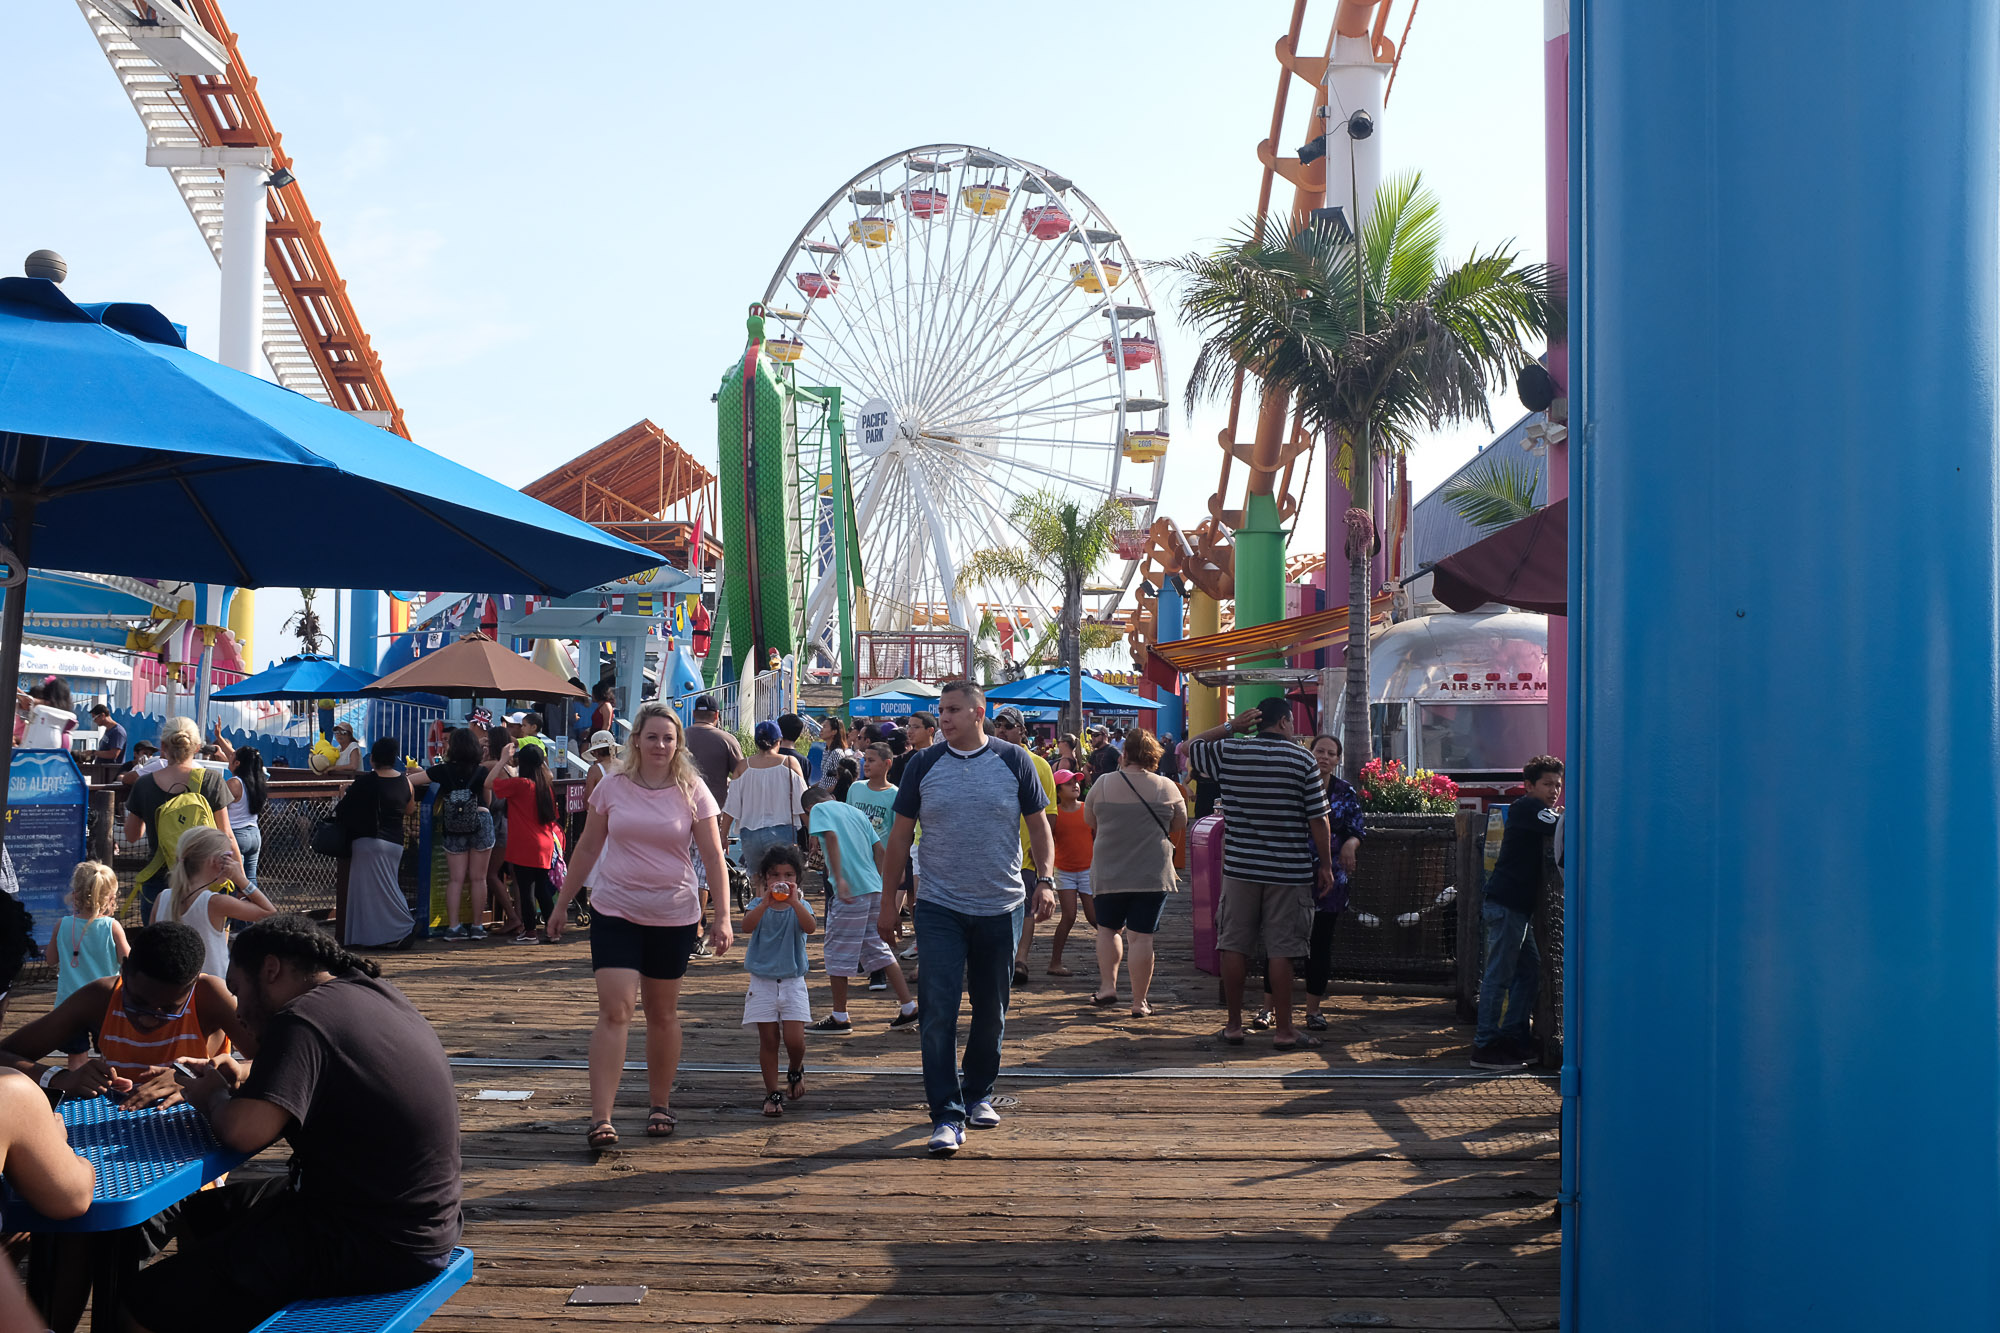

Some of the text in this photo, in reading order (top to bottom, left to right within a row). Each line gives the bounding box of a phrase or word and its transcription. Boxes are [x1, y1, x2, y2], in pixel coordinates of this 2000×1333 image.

[861, 411, 888, 429] PACIFIC
[865, 427, 884, 443] PARK
[26, 660, 49, 670] Cream
[113, 667, 131, 676] Cream
[1439, 682, 1547, 691] AIRSTREAM
[880, 702, 912, 714] POPCORN
[10, 776, 26, 792] SIG
[570, 786, 584, 797] EXIT
